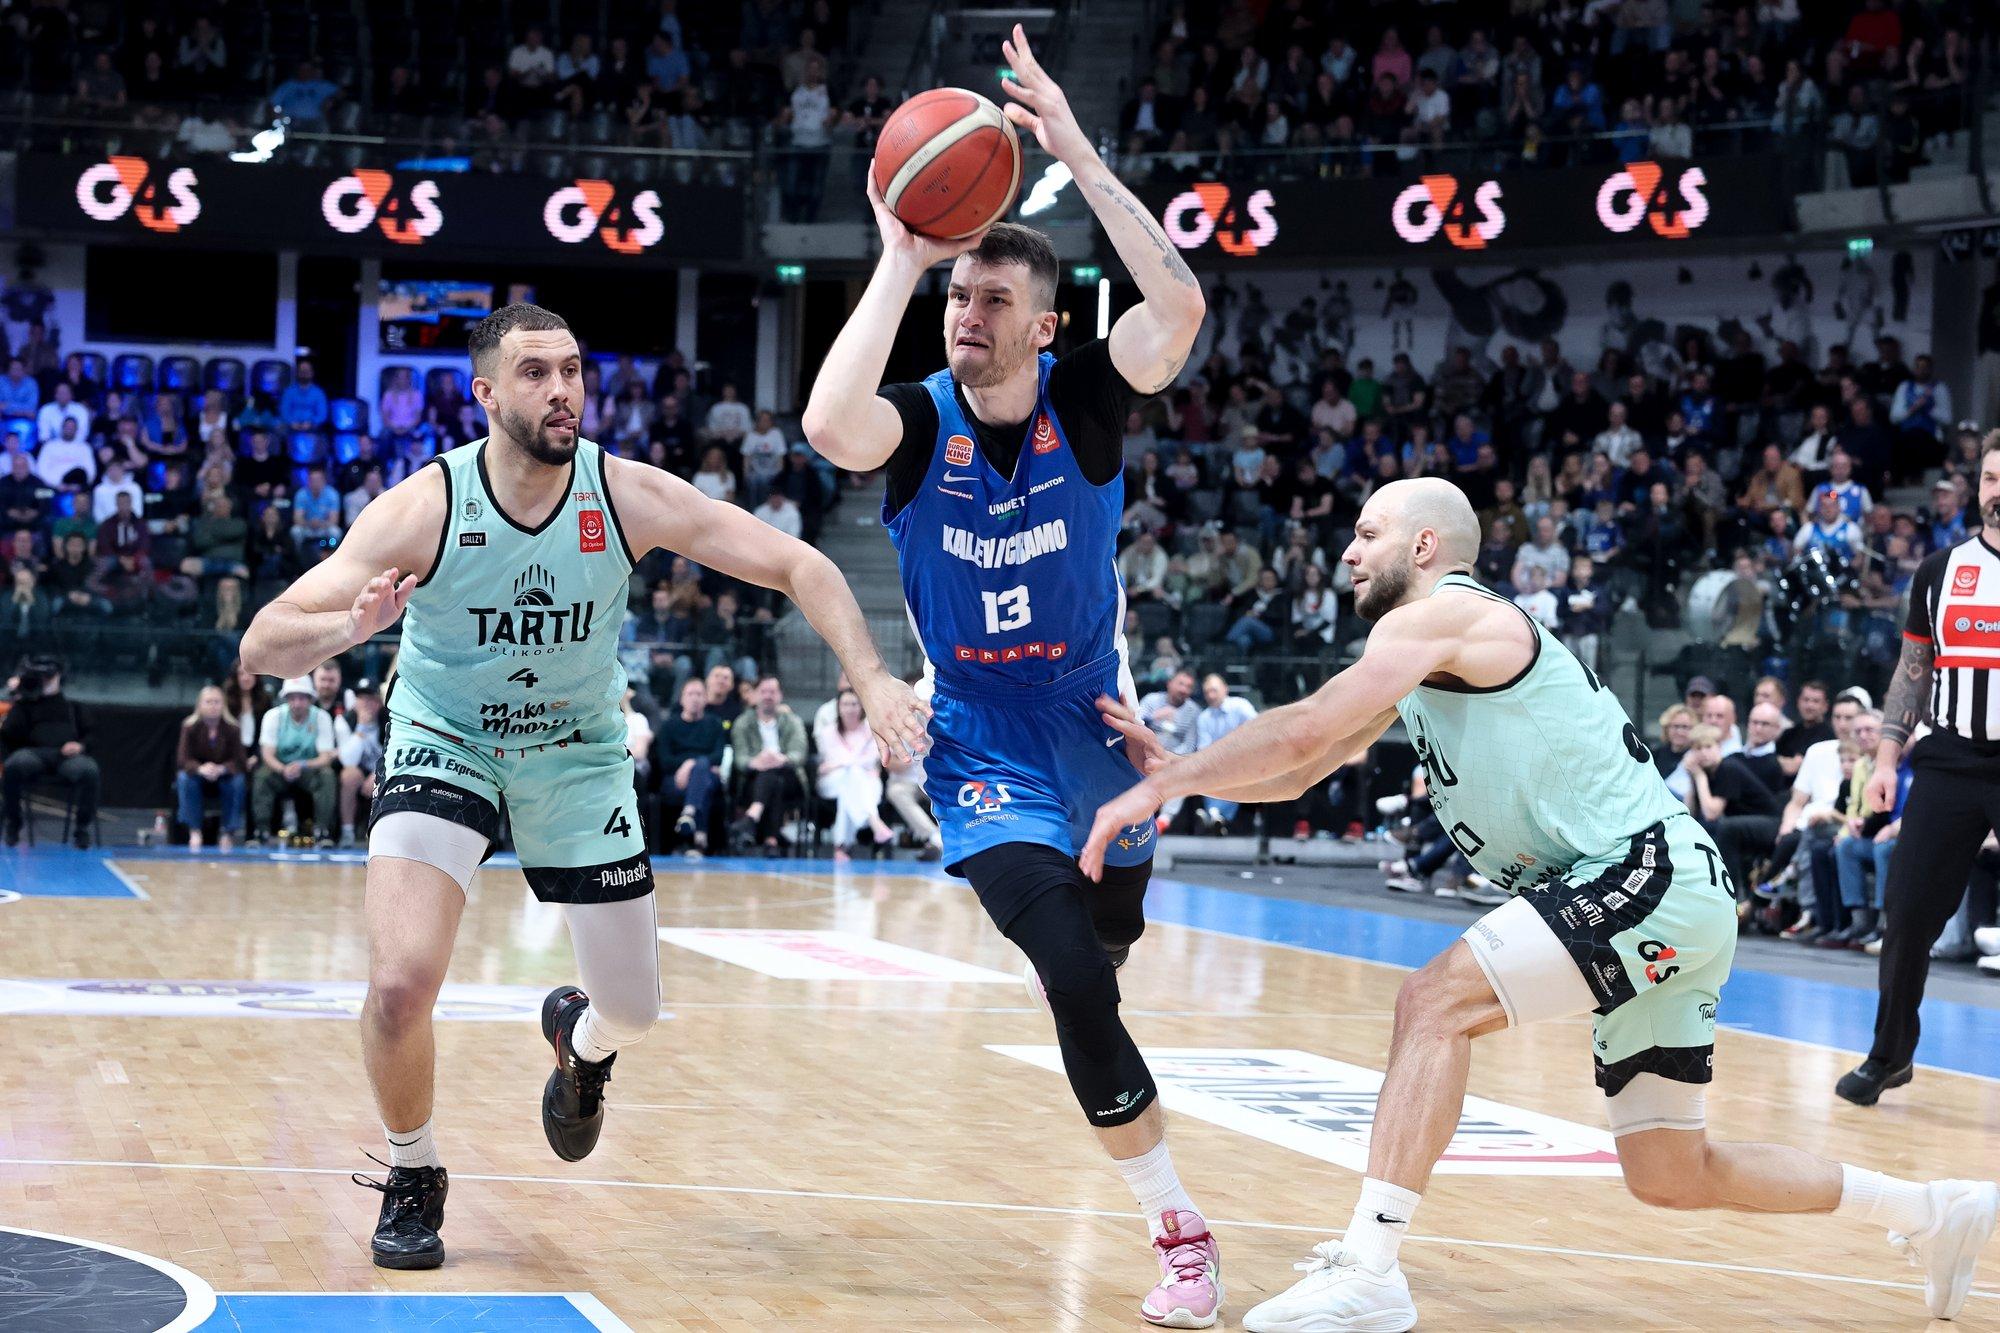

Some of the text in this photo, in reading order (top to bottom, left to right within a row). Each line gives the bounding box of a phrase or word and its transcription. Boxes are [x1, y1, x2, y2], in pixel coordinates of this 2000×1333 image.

[76, 156, 201, 233] G4S
[321, 169, 444, 245] G4S
[1391, 174, 1506, 249] G4S
[1596, 161, 1710, 238] G4S
[543, 179, 665, 254] G4S
[1163, 182, 1278, 256] G4S
[946, 449, 972, 461] KING
[948, 442, 972, 453] BURGER
[461, 535, 483, 544] BALLZY
[466, 600, 594, 647] TARTU
[981, 584, 1032, 634] 13
[960, 643, 1062, 660] CRAMO
[507, 667, 539, 689] 4
[393, 747, 440, 770] LUX
[603, 805, 632, 838] 4
[1096, 1088, 1145, 1116] GAMEPATCH
